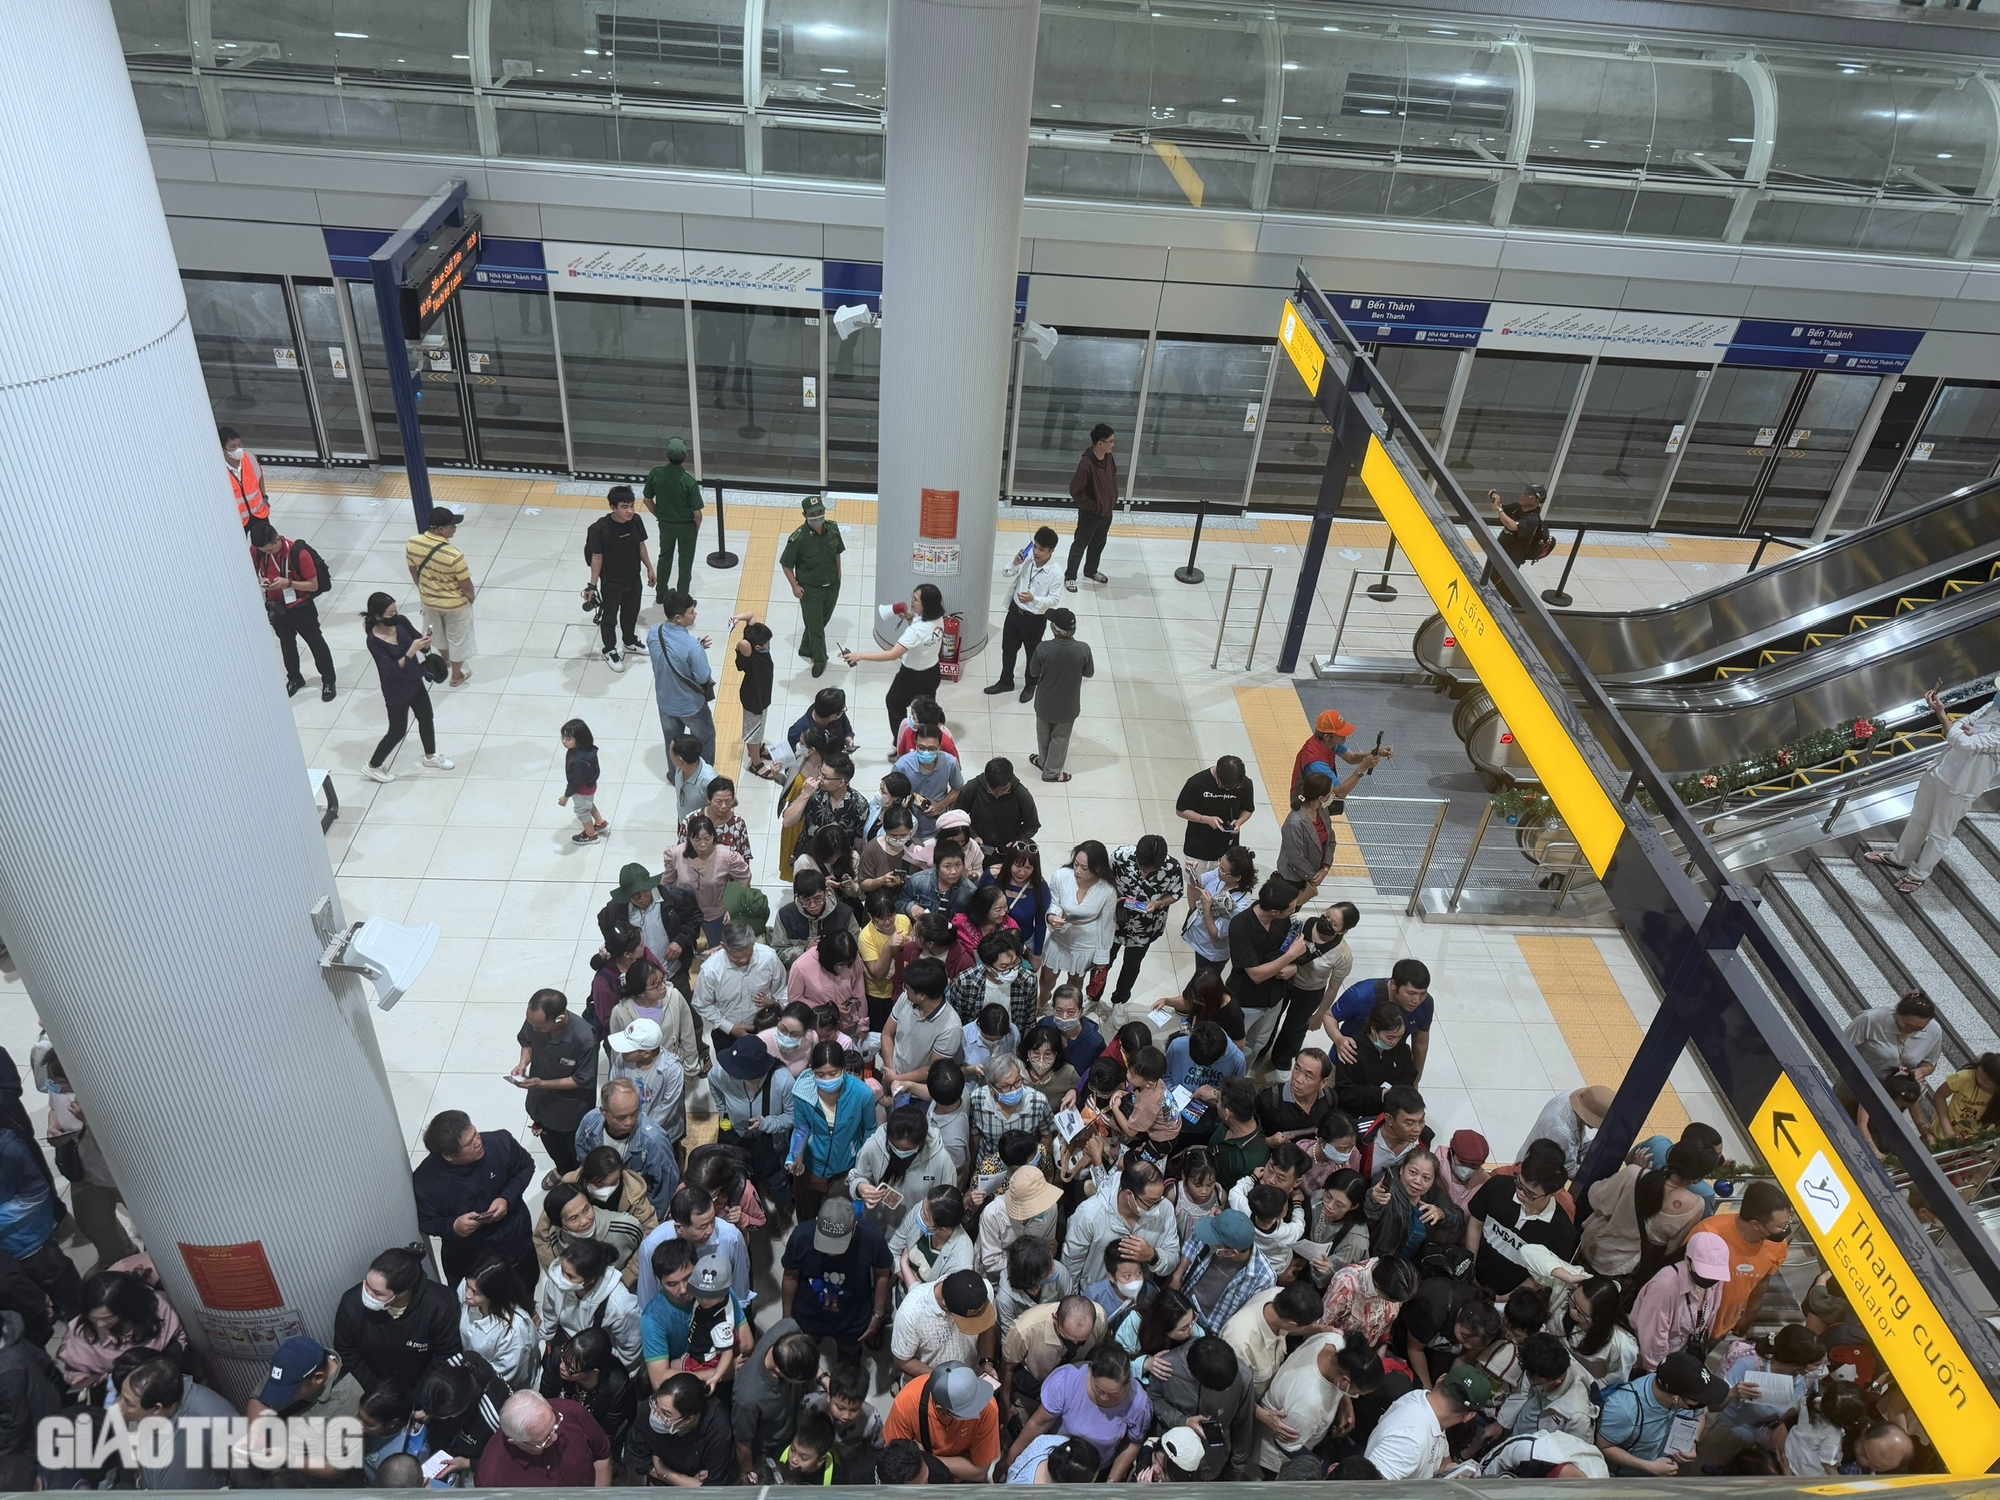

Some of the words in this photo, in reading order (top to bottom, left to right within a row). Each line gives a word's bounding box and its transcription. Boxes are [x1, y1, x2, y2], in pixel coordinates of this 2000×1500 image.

[1367, 299, 1385, 310] Bến
[1388, 301, 1415, 312] Thành
[1371, 311, 1384, 319] Ben
[1386, 312, 1405, 320] Thanh
[1807, 328, 1825, 338] Bến
[1827, 329, 1853, 340] Thành
[1809, 338, 1822, 346] Ben
[1822, 339, 1842, 347] Thanh
[1463, 595, 1478, 622] Lối
[1475, 617, 1485, 636] ra
[1457, 617, 1468, 638] Exit
[1203, 791, 1237, 800] Champion
[1832, 1237, 1897, 1339] Escalator
[1850, 1212, 1911, 1321] Thang
[1913, 1323, 1970, 1411] cuốn
